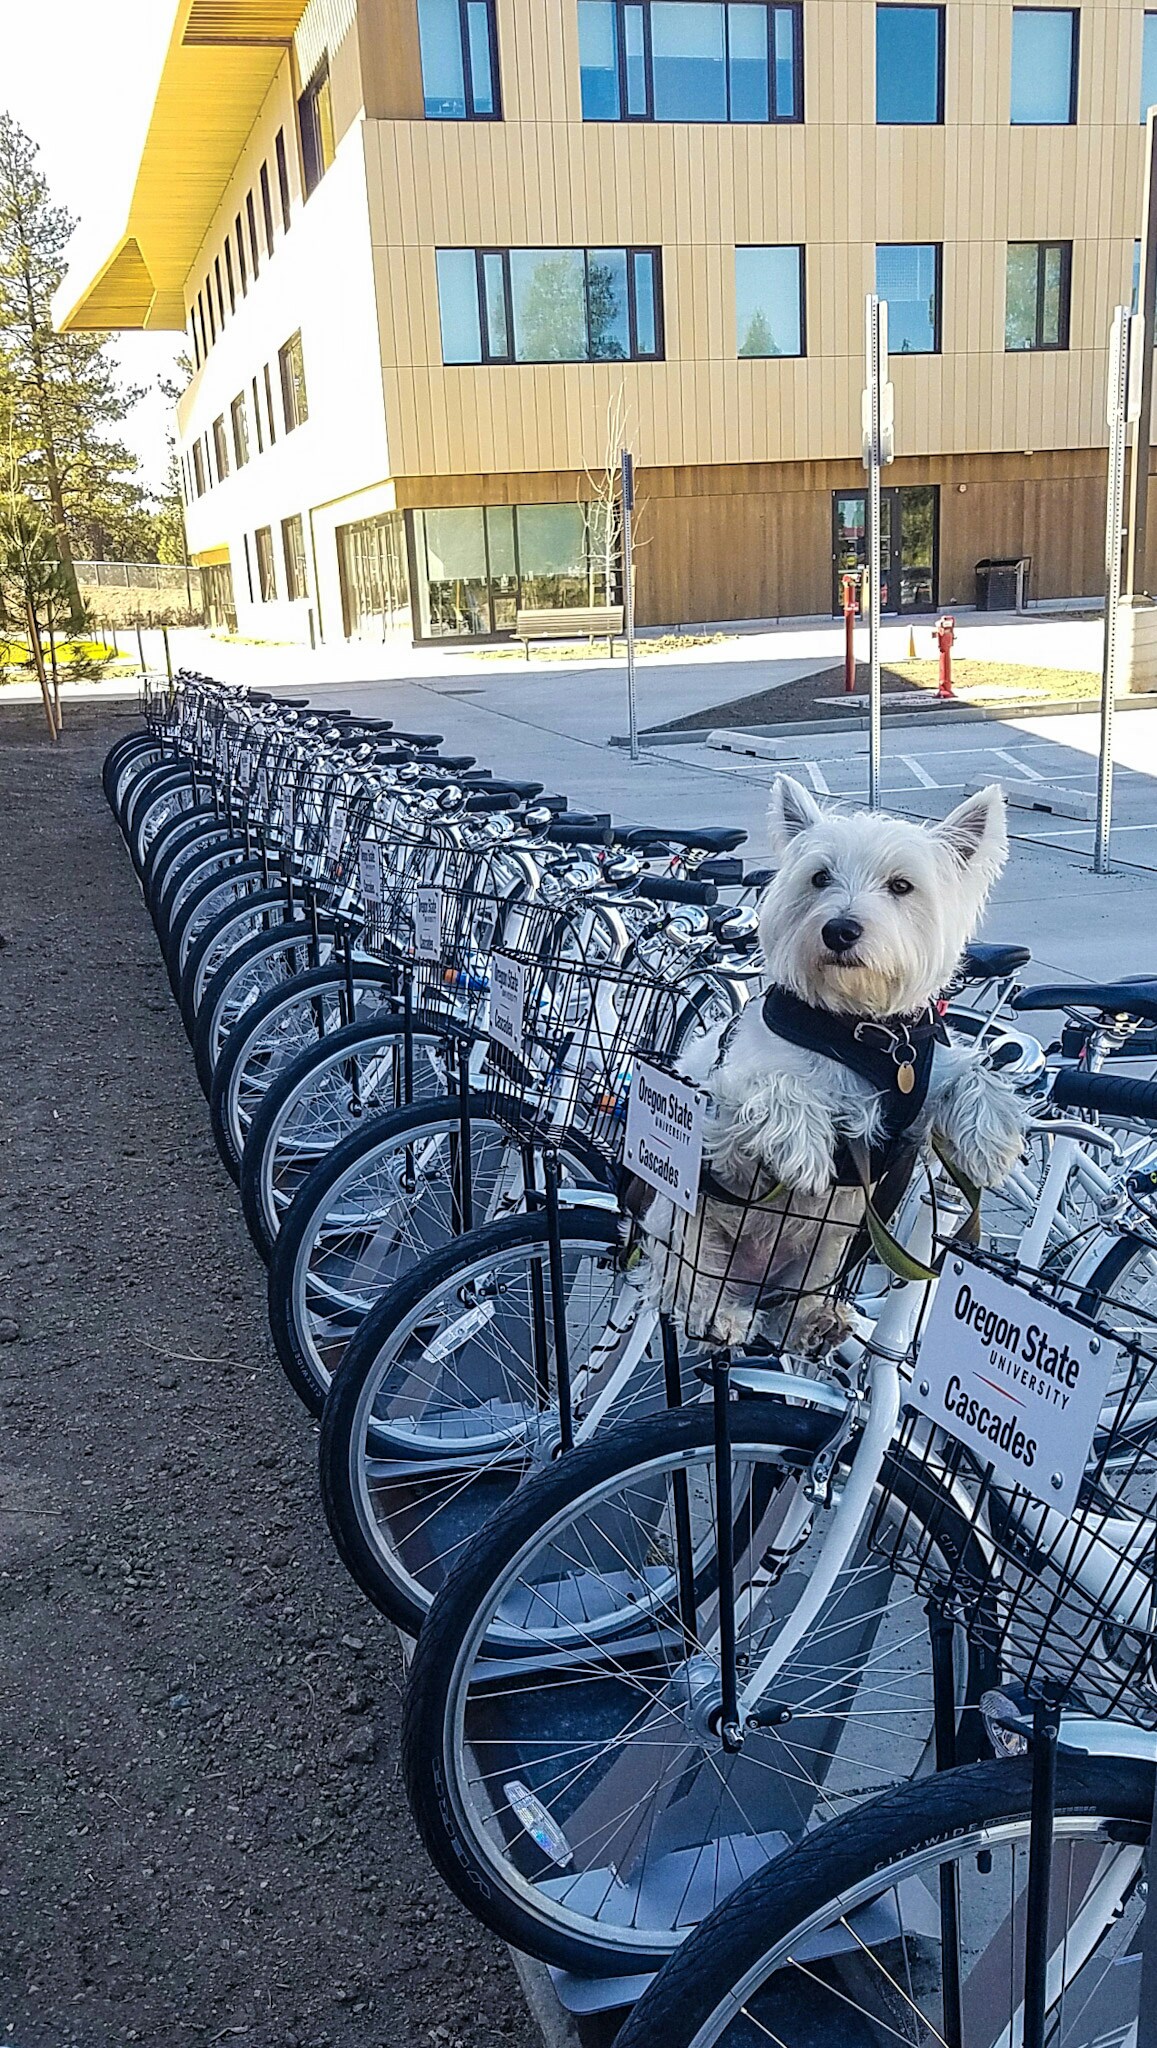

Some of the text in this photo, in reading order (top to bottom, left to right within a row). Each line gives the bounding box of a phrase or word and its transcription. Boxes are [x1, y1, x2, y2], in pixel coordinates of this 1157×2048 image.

[638, 1075, 693, 1131] Oregon State
[654, 1115, 691, 1146] UNIVERSITY
[638, 1138, 680, 1189] Cascades
[954, 1284, 1080, 1389] Oregon State
[294, 1353, 322, 1398] CITYWIDE
[989, 1349, 1071, 1411] UNIVERSITY
[944, 1375, 1037, 1468] Cascades
[874, 1822, 979, 1873] CITYWIDE
